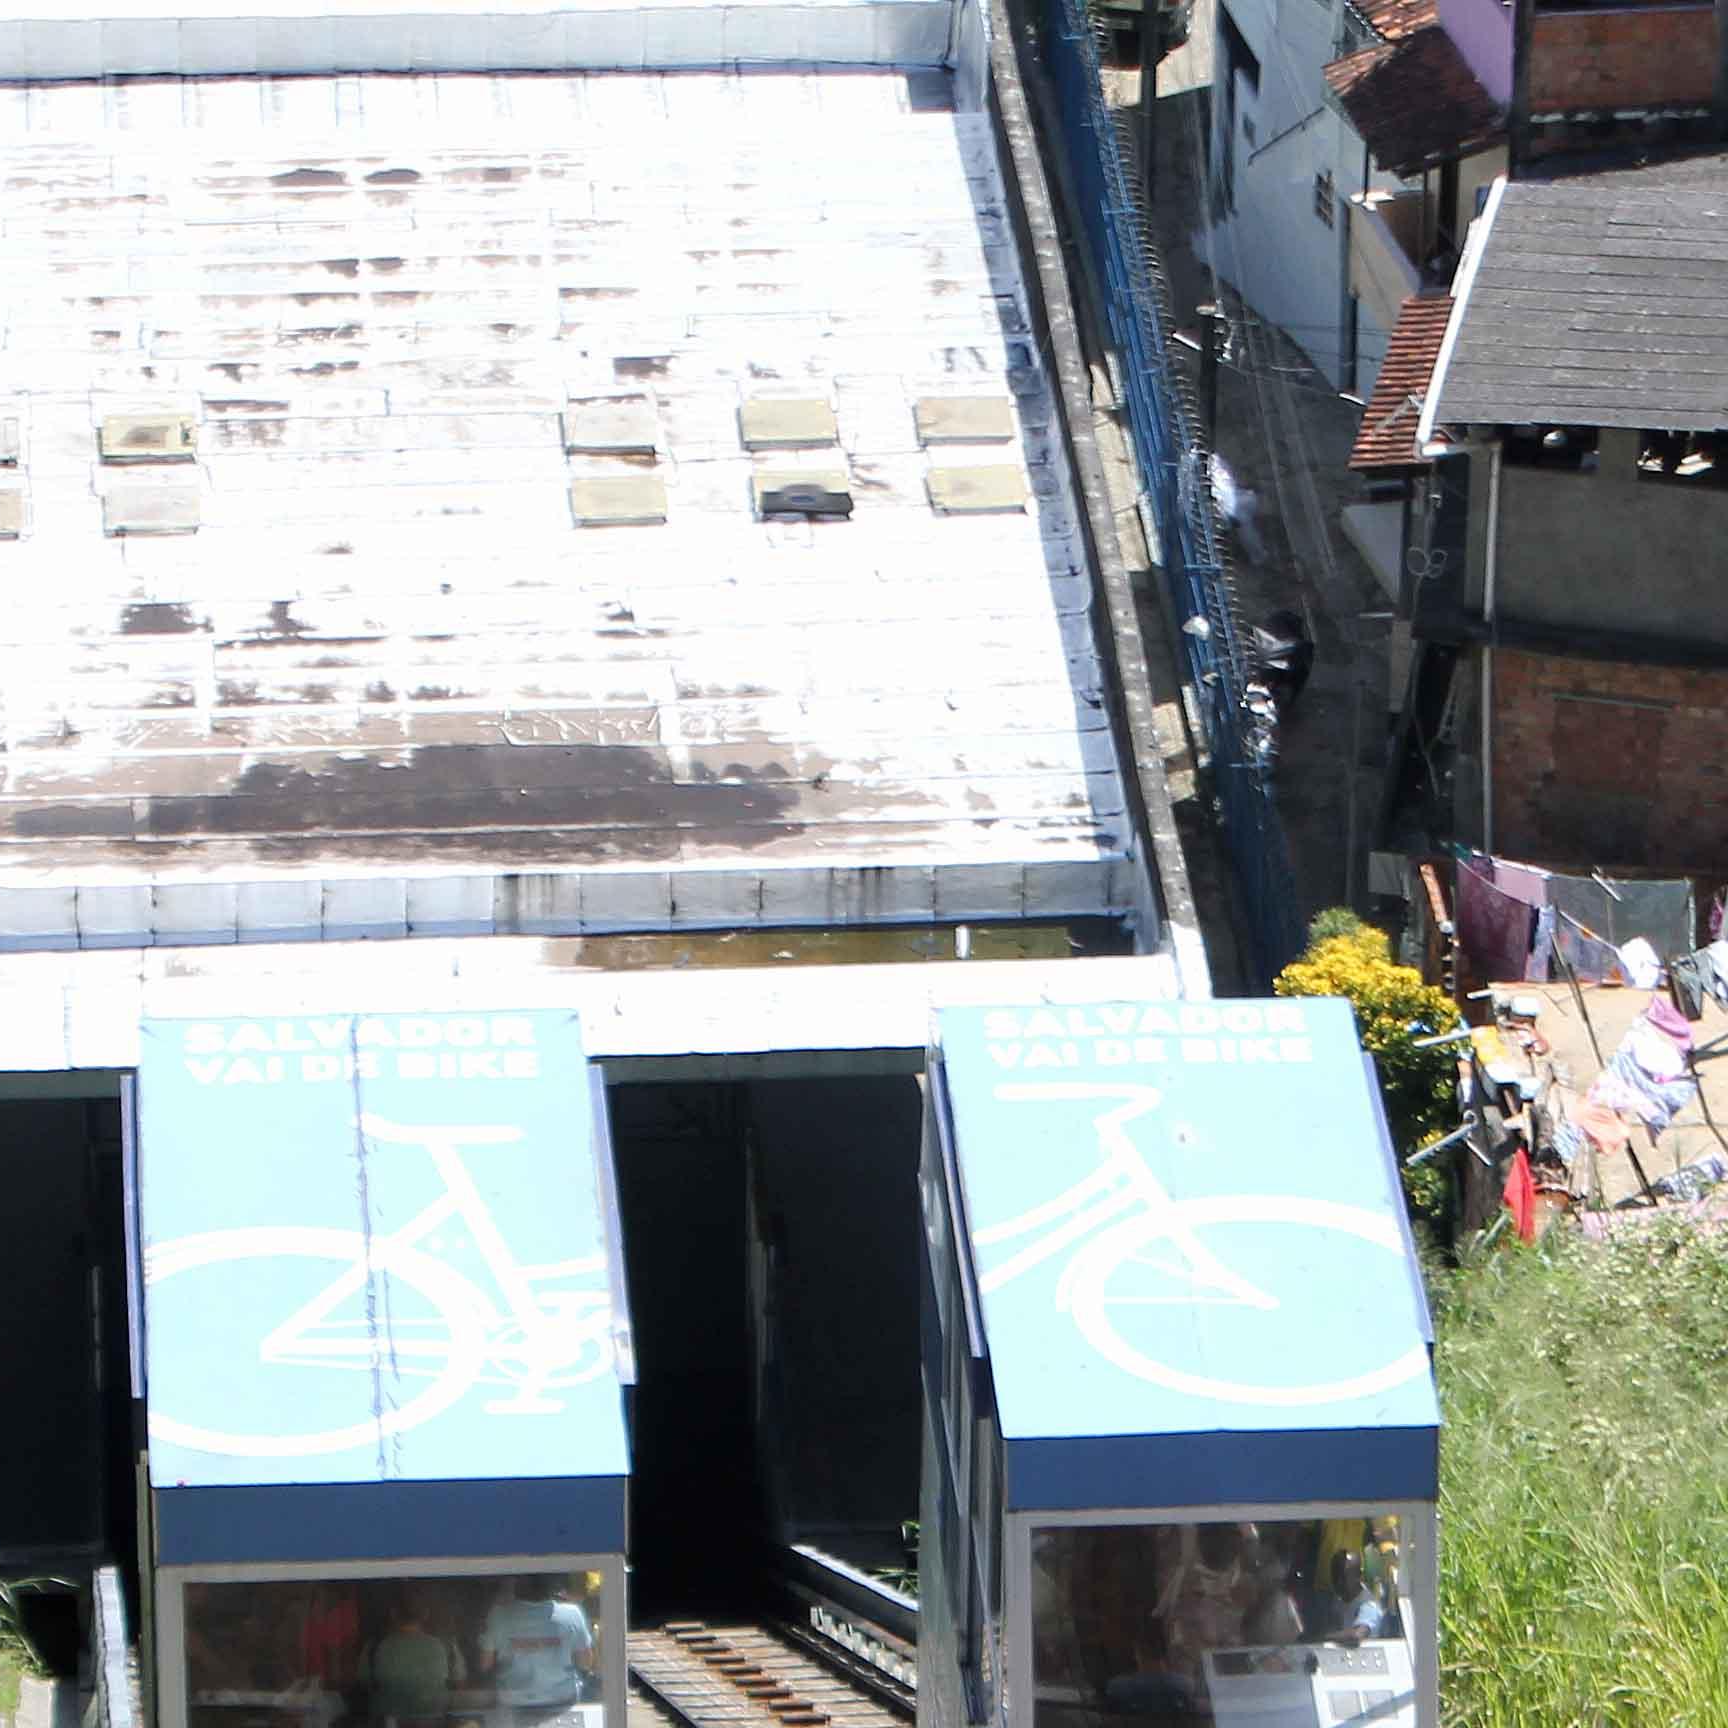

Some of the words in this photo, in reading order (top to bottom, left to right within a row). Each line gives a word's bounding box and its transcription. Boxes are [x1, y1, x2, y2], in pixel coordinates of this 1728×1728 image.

[183, 1017, 538, 1052] SALVADOR
[983, 1006, 1307, 1039] SALVADOR
[183, 1054, 285, 1084] VAI
[302, 1053, 378, 1082] DE
[399, 1050, 540, 1080] BIKE
[985, 1043, 1079, 1068] VAI
[1094, 1039, 1168, 1065] DE
[1181, 1037, 1312, 1064] BIKE
